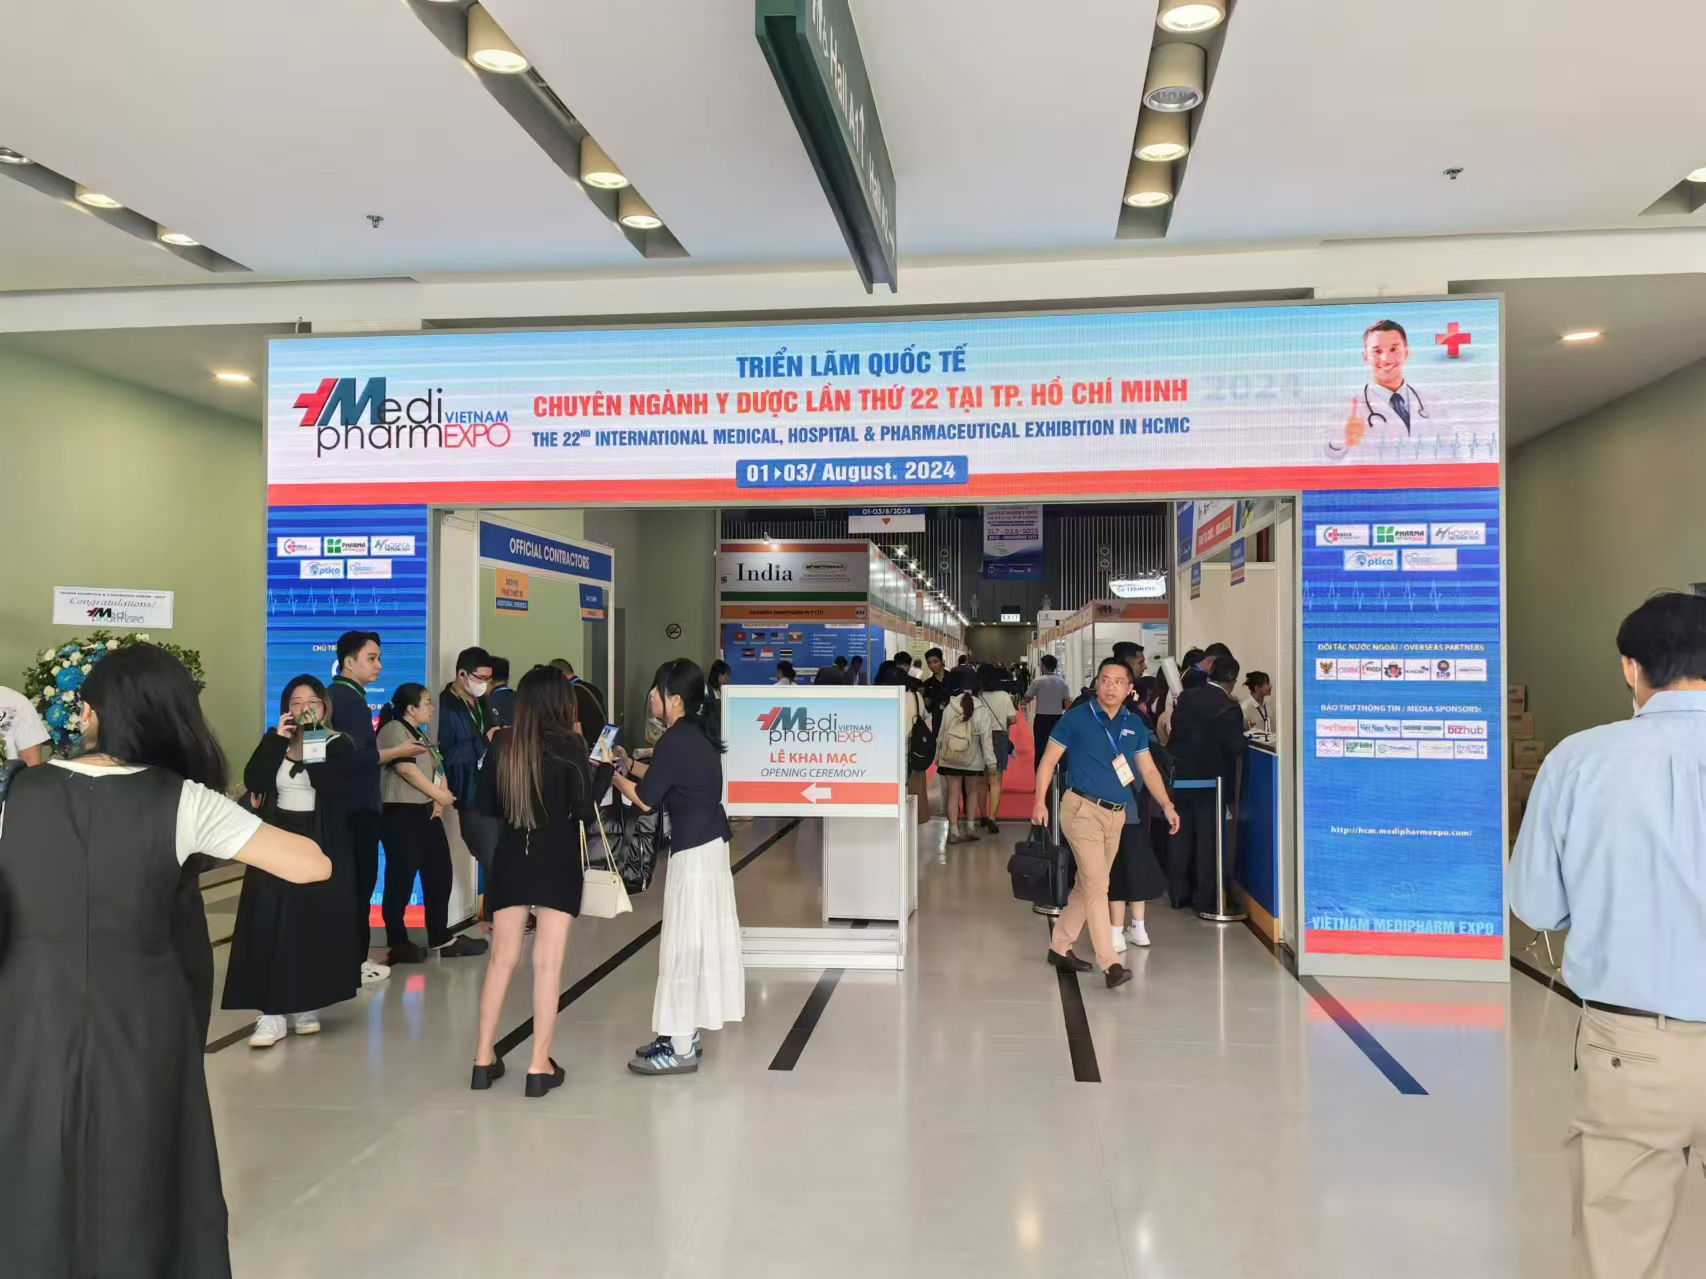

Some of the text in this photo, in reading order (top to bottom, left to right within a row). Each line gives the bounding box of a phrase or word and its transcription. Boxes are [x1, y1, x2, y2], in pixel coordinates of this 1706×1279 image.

[830, 25, 848, 124] Hall
[869, 151, 881, 221] Hall
[737, 343, 968, 378] TRIỂN LÃM QUỐC TẾ
[317, 377, 443, 426] Medi
[533, 376, 1188, 418] CHUYÊN NGÀNH Y DƯỢC LẦN THỨ 22 TẠI TP. HỒ CHÍ MINH
[445, 410, 509, 424] VIETNAM
[317, 421, 443, 458] pharm
[444, 422, 511, 449] EXPO
[532, 431, 558, 447] THE
[595, 429, 708, 446] INTERNATIONAL
[713, 428, 784, 445] MEDICAL,
[788, 426, 859, 443] HOSPITAL
[864, 426, 875, 442] &
[880, 422, 1020, 441] PHARMACEUTICAL
[1025, 419, 1114, 437] EXHIBITION
[1120, 417, 1137, 435] IN
[1142, 417, 1190, 434] HCMC
[822, 461, 898, 483] August.
[904, 460, 956, 480] 2024
[509, 537, 590, 570] OFFICIAL CONTRACTORS
[736, 563, 793, 581] India
[69, 596, 157, 608] Congratulations!
[770, 706, 838, 731] Medi
[1387, 704, 1400, 712] TIN
[769, 728, 838, 745] pharm
[837, 730, 873, 743] EXPO
[1448, 724, 1484, 734] bizhub
[769, 749, 857, 766] LỄ KHAI MẠC
[761, 767, 866, 777] OPENING CEREMONY
[1331, 826, 1472, 837] http://hcm.medipharmexpo.com/
[1312, 916, 1494, 935] VIETNAM MEDIPHARM EXPO
